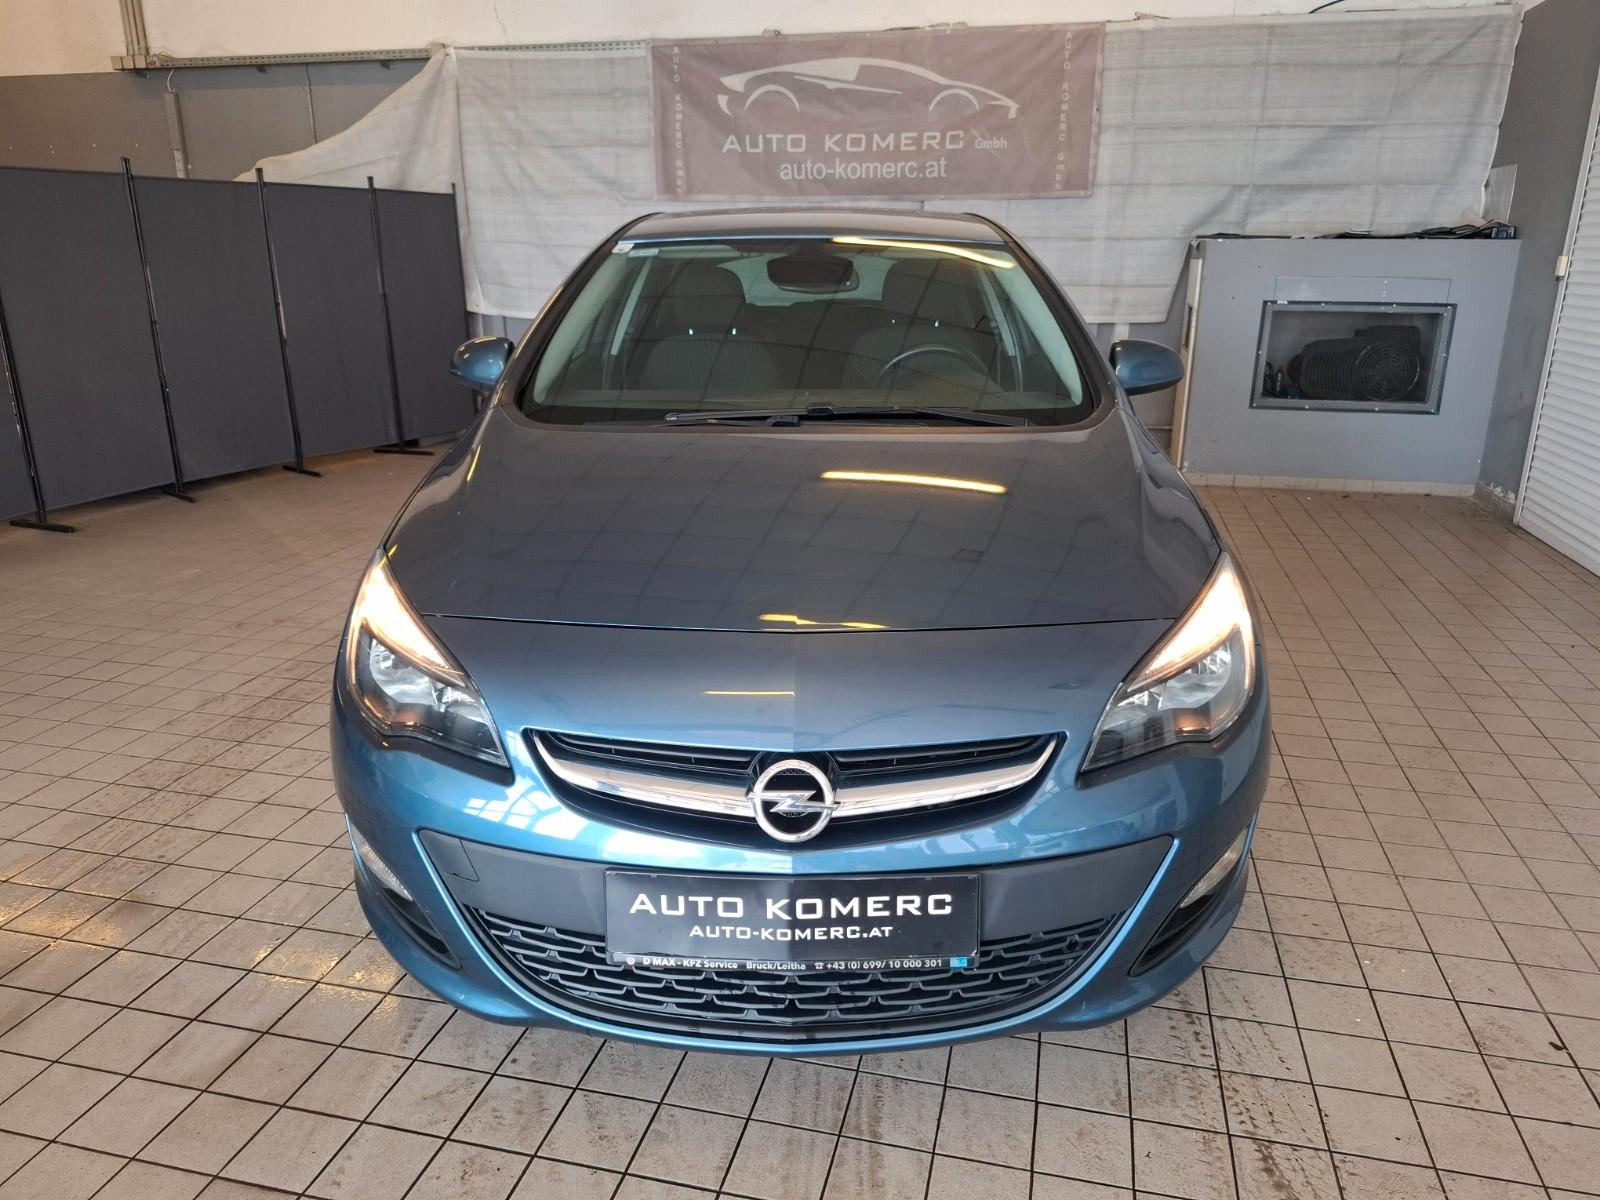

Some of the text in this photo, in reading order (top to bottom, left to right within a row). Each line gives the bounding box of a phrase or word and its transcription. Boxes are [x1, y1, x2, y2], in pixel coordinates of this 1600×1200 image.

[722, 130, 1008, 153] AUTO KOMERC Gmbh
[779, 156, 947, 181] auto-komerc.at
[628, 893, 953, 921] AUTO KOMERC
[689, 925, 894, 941] AUTO-KOMERC.AT
[643, 957, 651, 966] D
[652, 957, 676, 967] MAX
[683, 957, 702, 968] KFZ
[703, 959, 738, 969] Service
[746, 961, 806, 971] Bruck/Leitha
[826, 961, 845, 970] +43
[847, 961, 861, 970] (0)
[862, 960, 886, 970] 699/
[888, 960, 901, 969] 10
[903, 960, 922, 969] 000
[924, 959, 942, 968] 301
